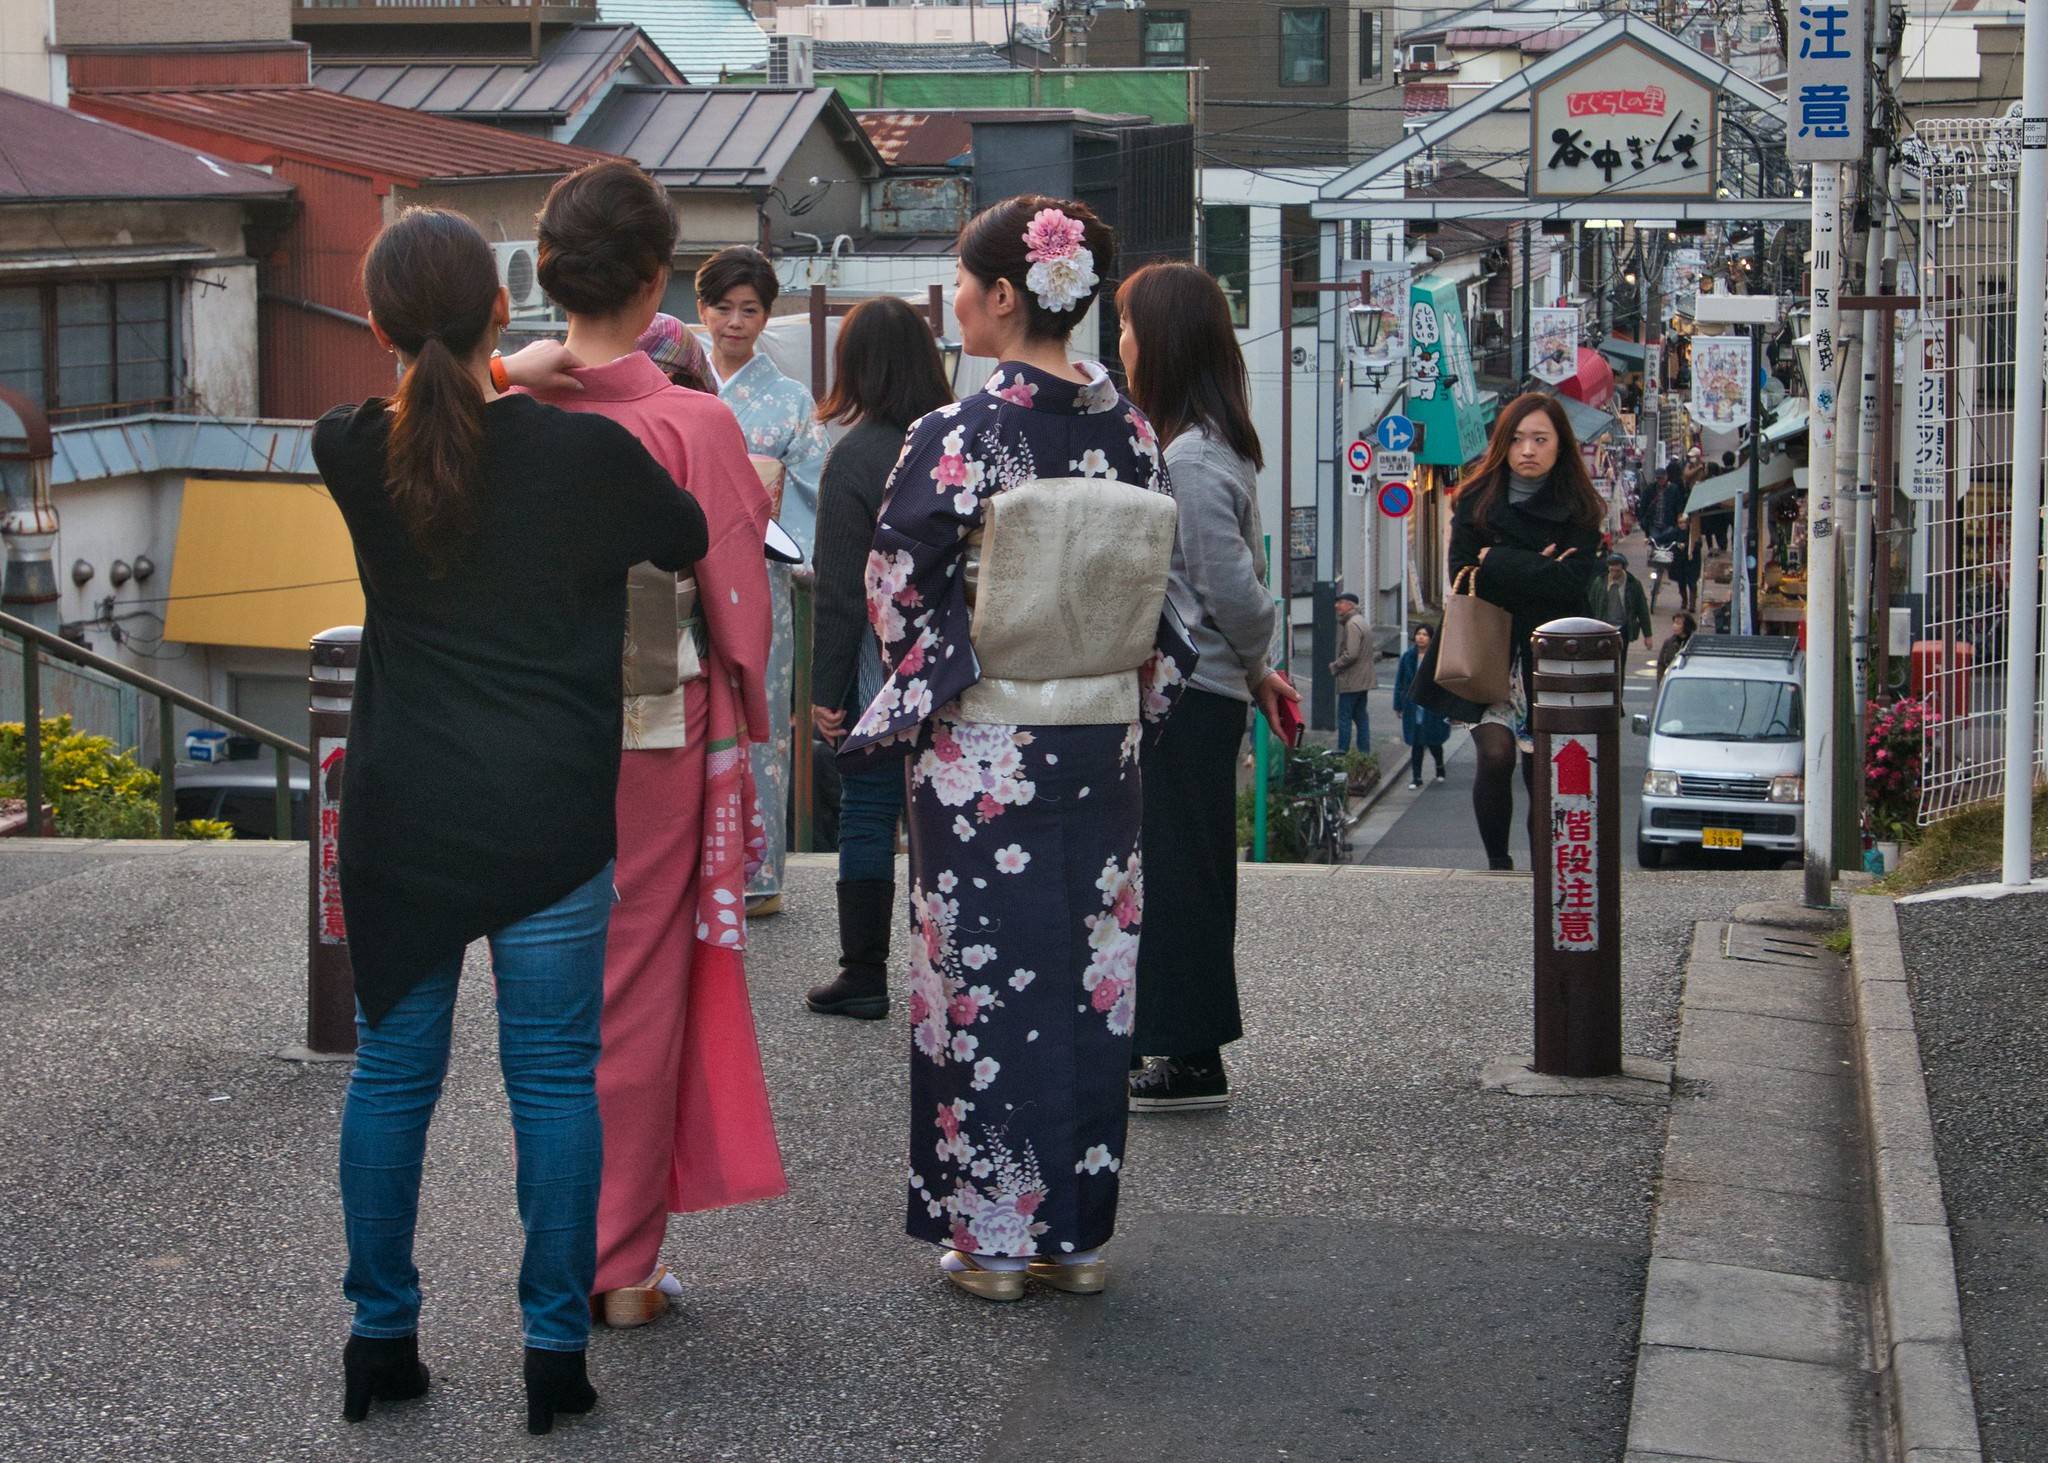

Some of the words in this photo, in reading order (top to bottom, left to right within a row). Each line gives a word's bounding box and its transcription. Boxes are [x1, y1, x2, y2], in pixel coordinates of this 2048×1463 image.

[1569, 85, 1665, 116] ひぐらしの里
[1798, 5, 1851, 138] 注意
[1548, 110, 1699, 182] 谷中ぎんざ
[1814, 211, 1831, 307] 川区
[1916, 377, 1934, 465] クリニック
[1552, 810, 1594, 943] 階段注意
